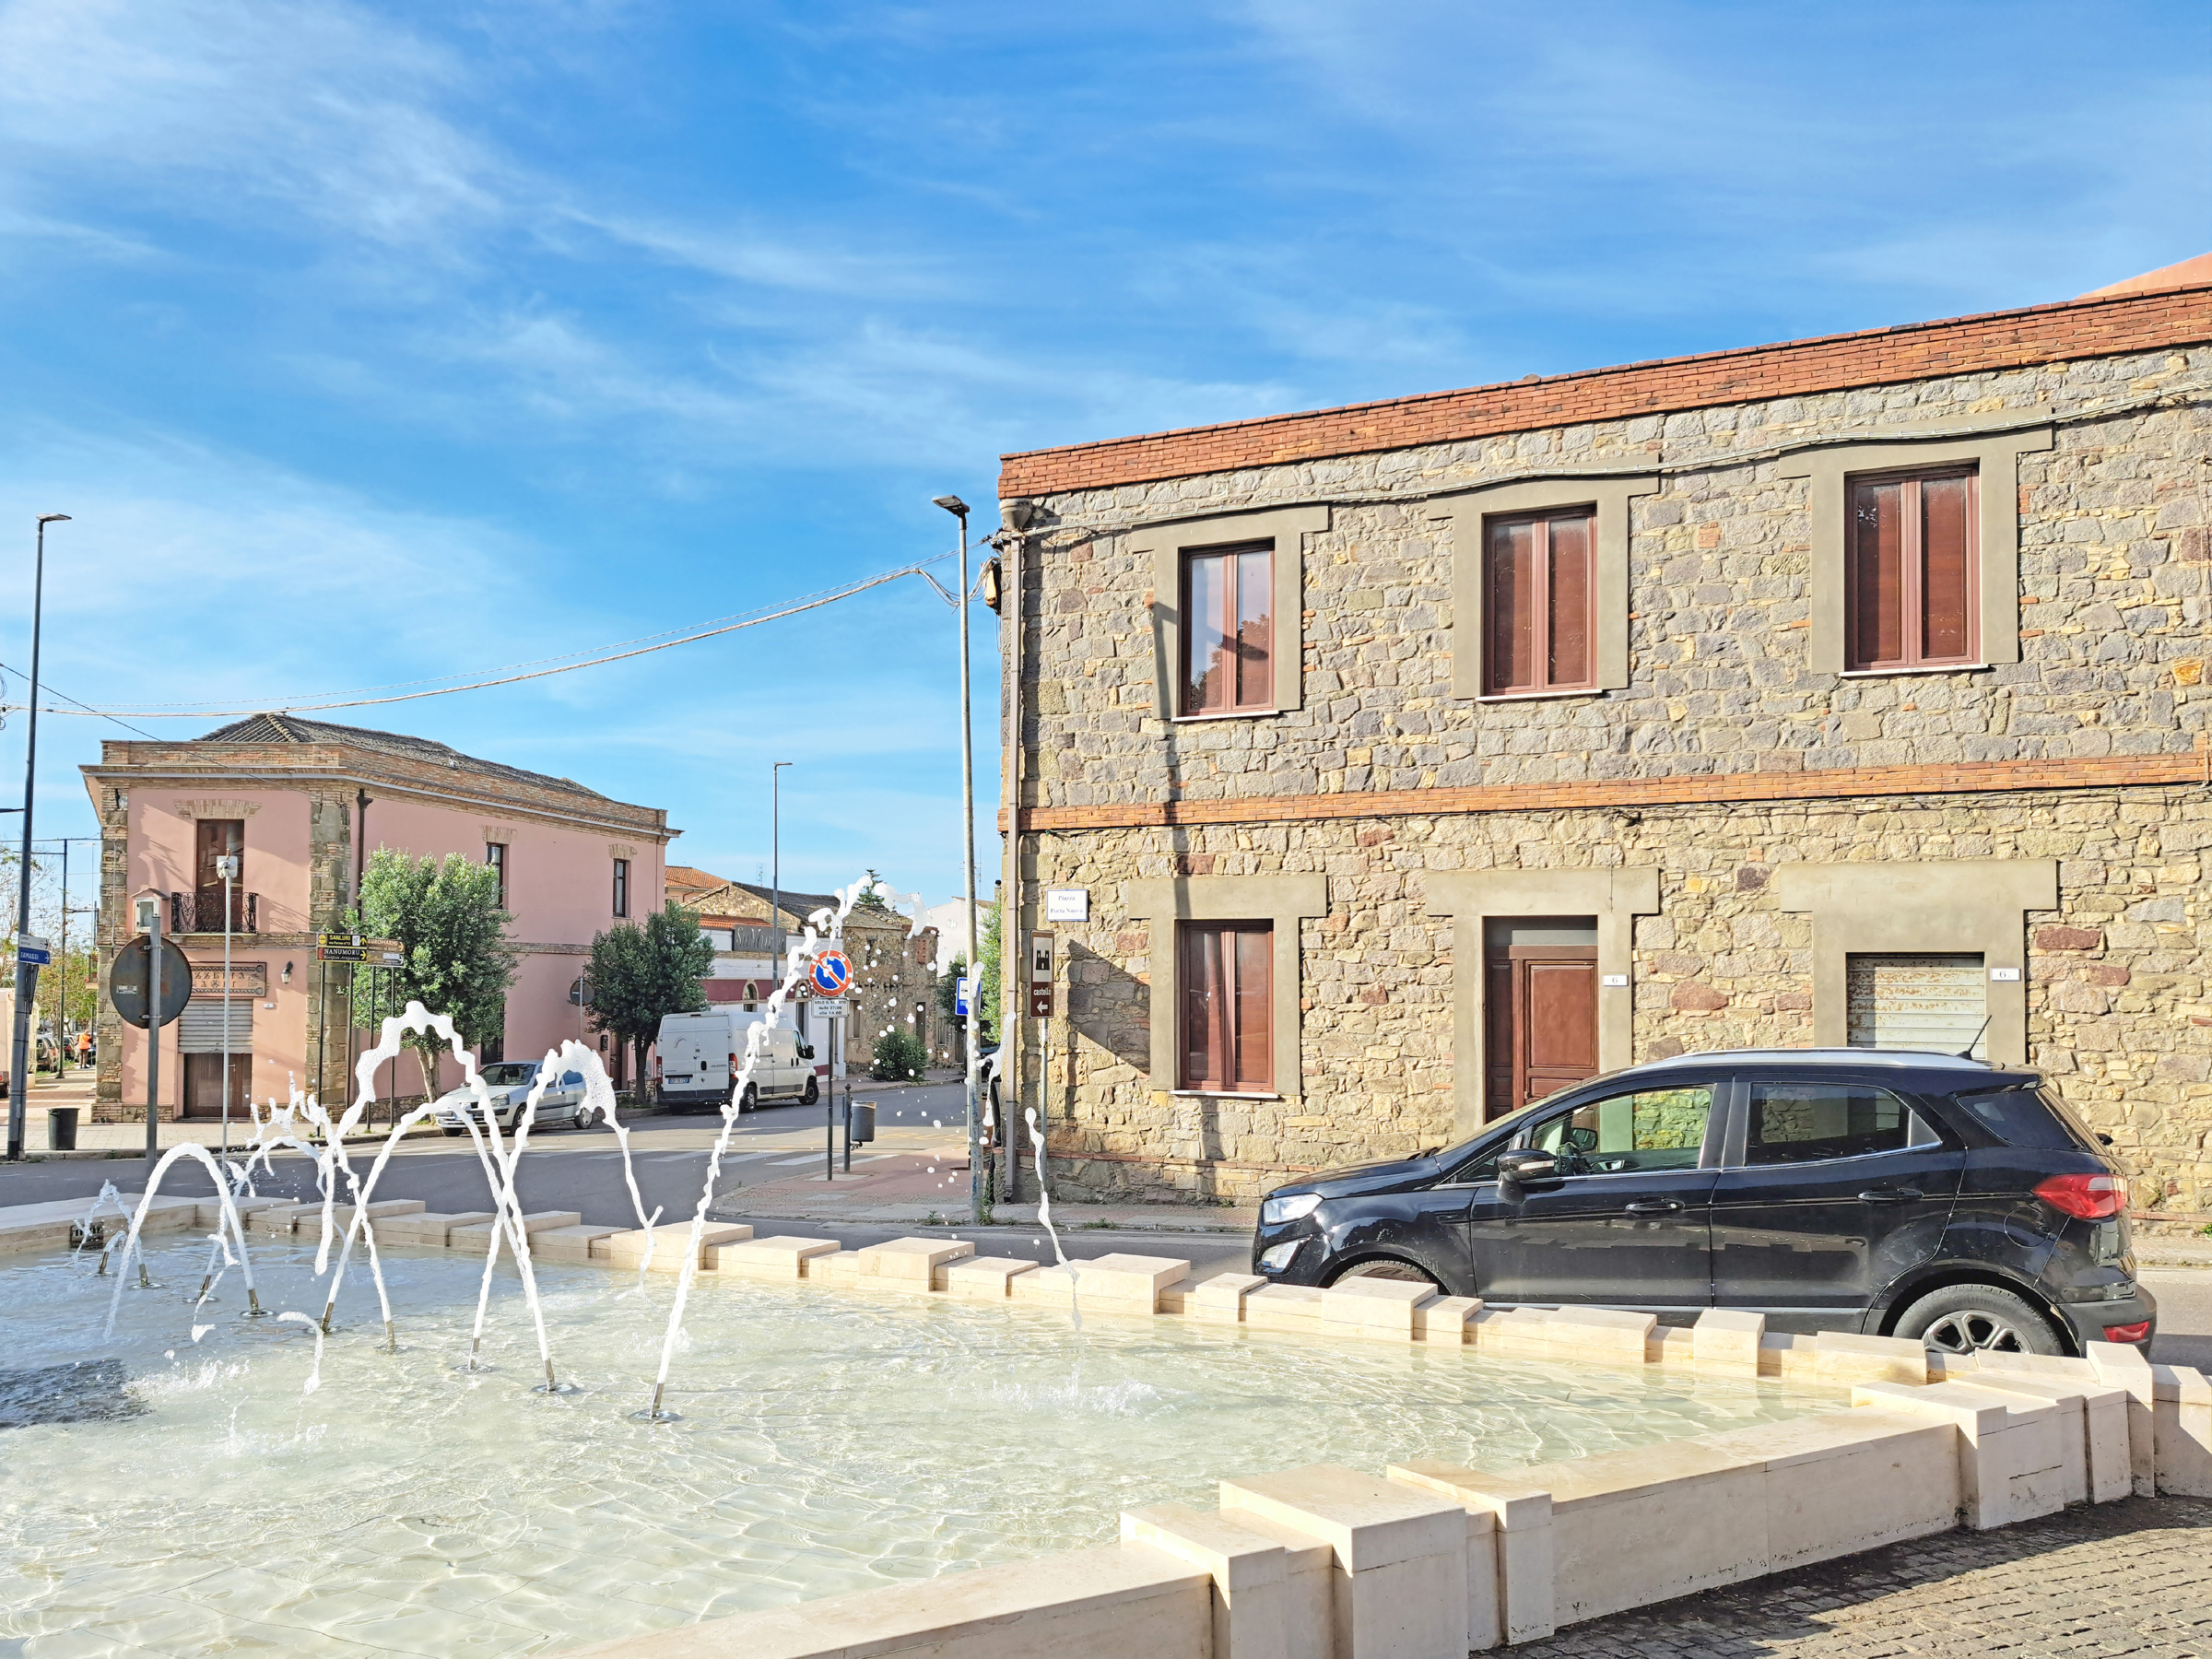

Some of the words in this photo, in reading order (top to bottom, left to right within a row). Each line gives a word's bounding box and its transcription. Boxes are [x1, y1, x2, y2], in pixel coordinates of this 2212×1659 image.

[19, 951, 40, 960] SAMASSI
[1611, 976, 1618, 984] 6
[1033, 987, 1052, 996] castello
